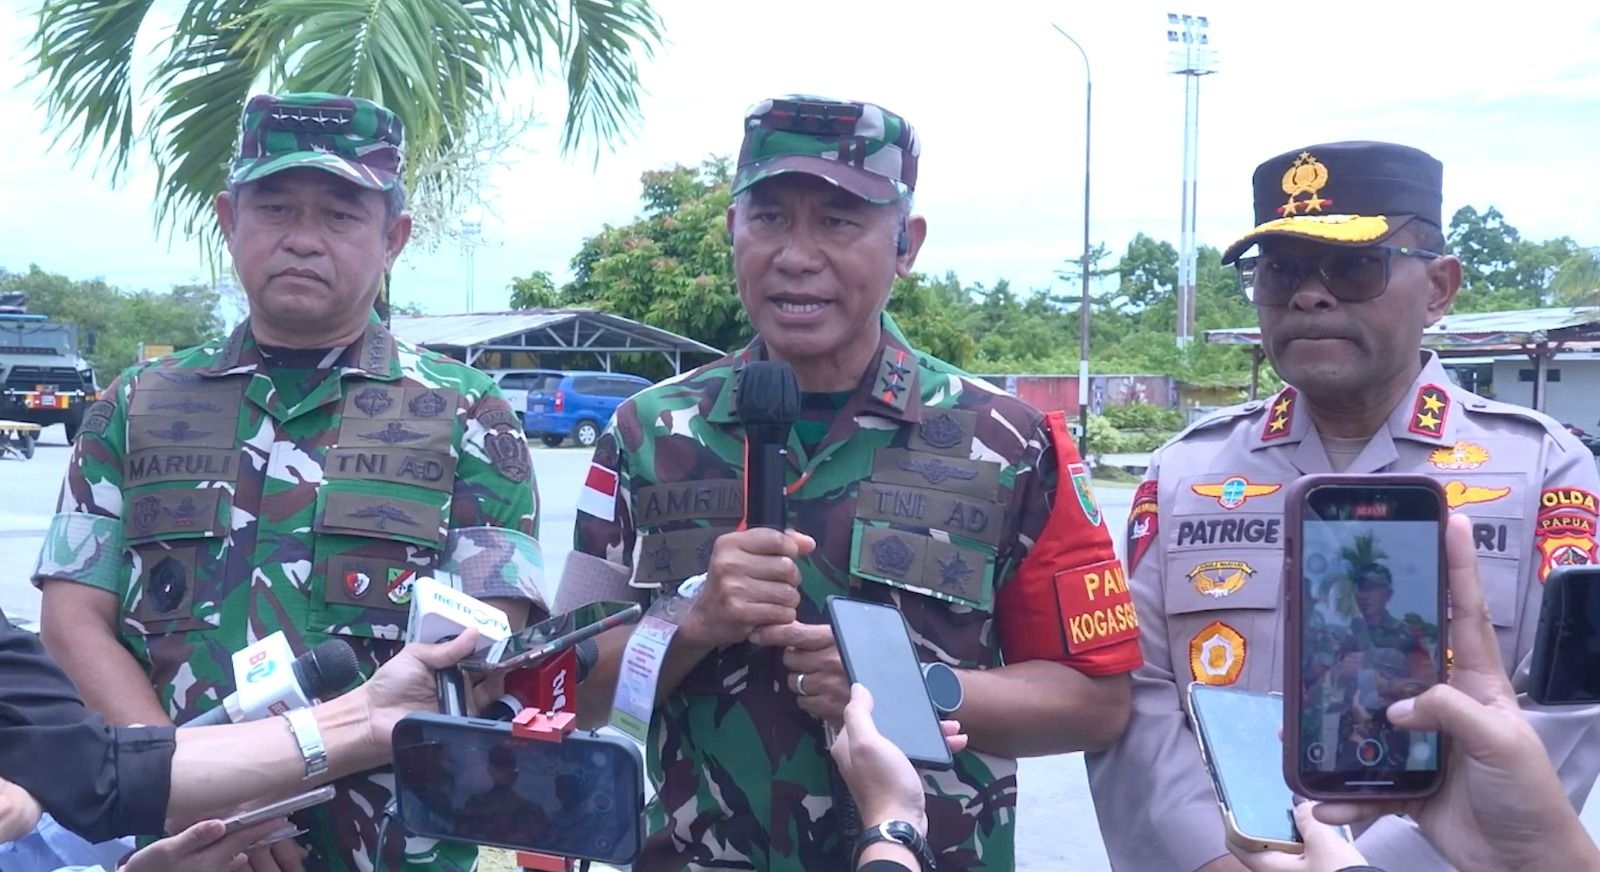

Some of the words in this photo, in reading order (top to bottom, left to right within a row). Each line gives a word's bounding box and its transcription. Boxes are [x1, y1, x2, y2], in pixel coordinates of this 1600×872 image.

[129, 454, 231, 480] MARULI
[336, 453, 387, 475] TNI
[873, 489, 926, 520] TNI
[944, 500, 988, 533] AD
[1539, 490, 1596, 511] OLDA
[1177, 518, 1281, 546] PATRIGE
[1542, 517, 1590, 529] PAPUA
[1473, 523, 1507, 552] RI
